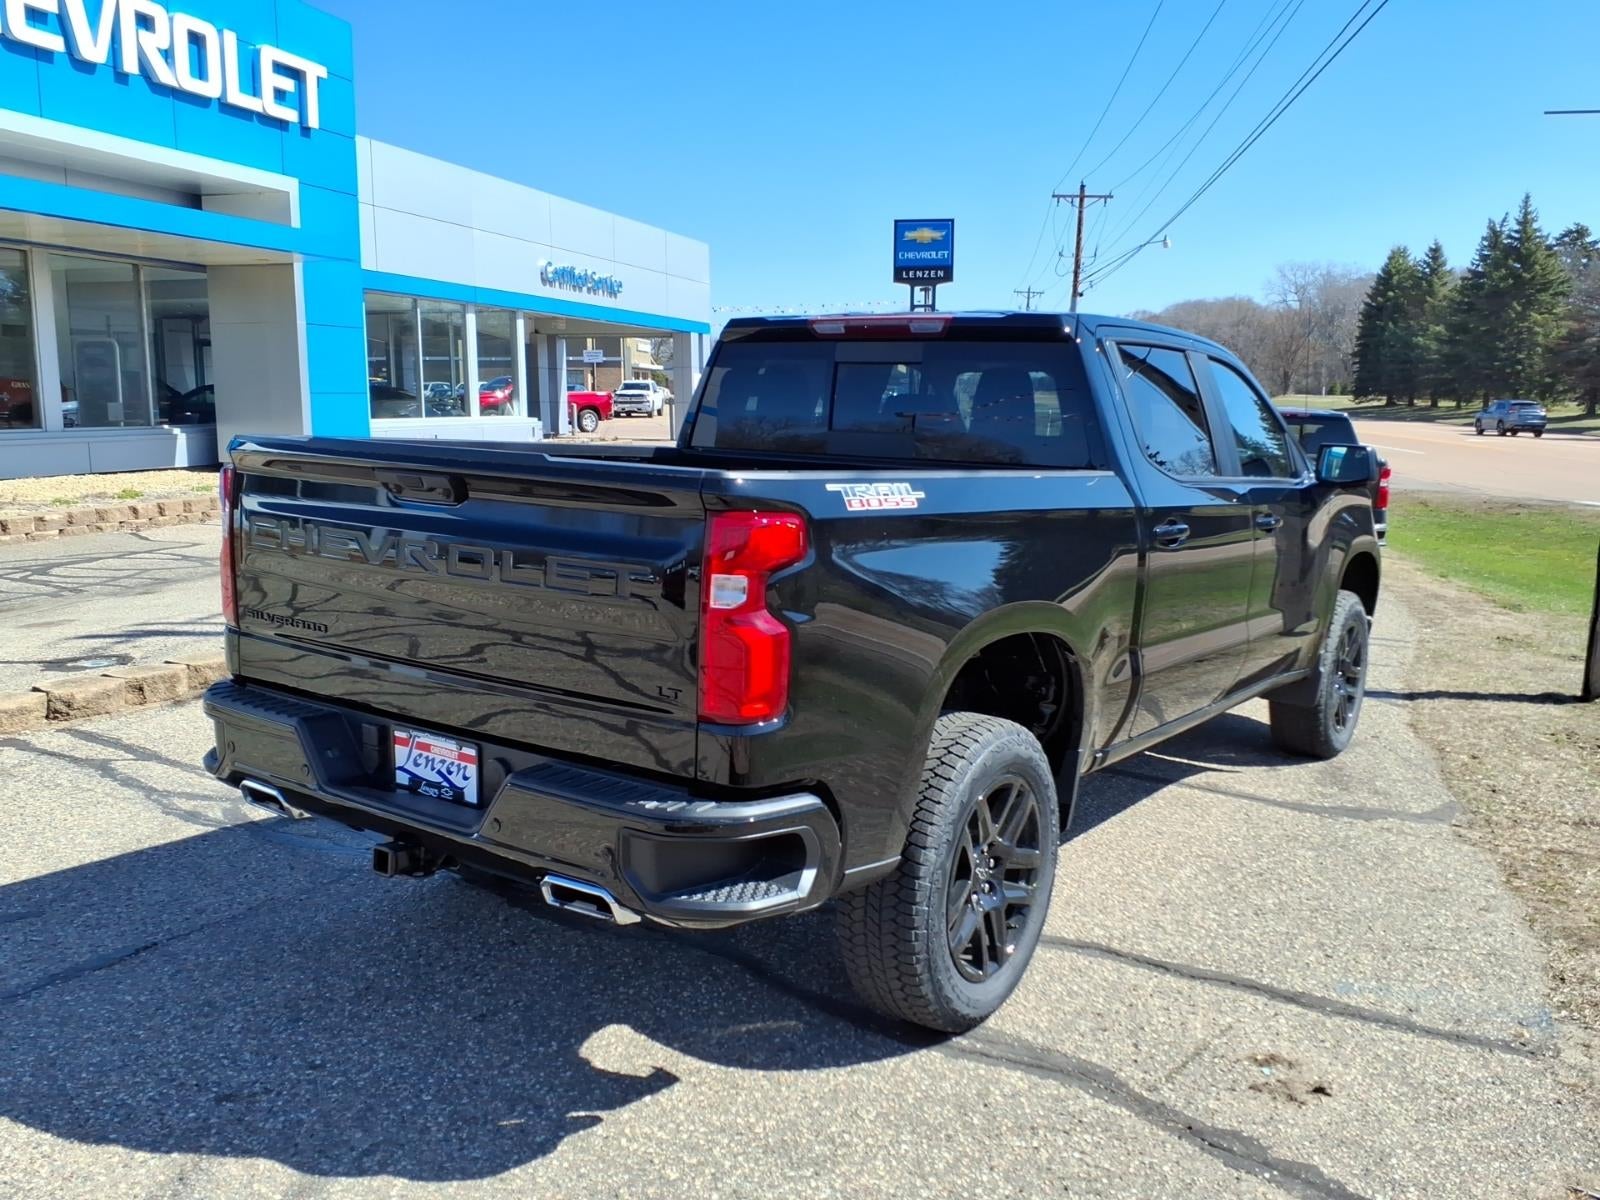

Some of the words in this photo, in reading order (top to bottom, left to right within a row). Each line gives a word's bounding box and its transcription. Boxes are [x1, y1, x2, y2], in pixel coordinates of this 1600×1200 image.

[0, 0, 328, 129] EVROLET
[898, 250, 949, 260] CHEVROLET
[541, 261, 588, 290] Certified
[589, 271, 623, 297] Service
[902, 270, 944, 278] LENZEN
[825, 482, 926, 500] TRAIL
[844, 497, 918, 511] BOSS
[249, 515, 656, 601] CHEVROLET
[245, 607, 329, 633] SILVERADO
[655, 685, 683, 700] LT
[396, 733, 471, 790] Lenzen
